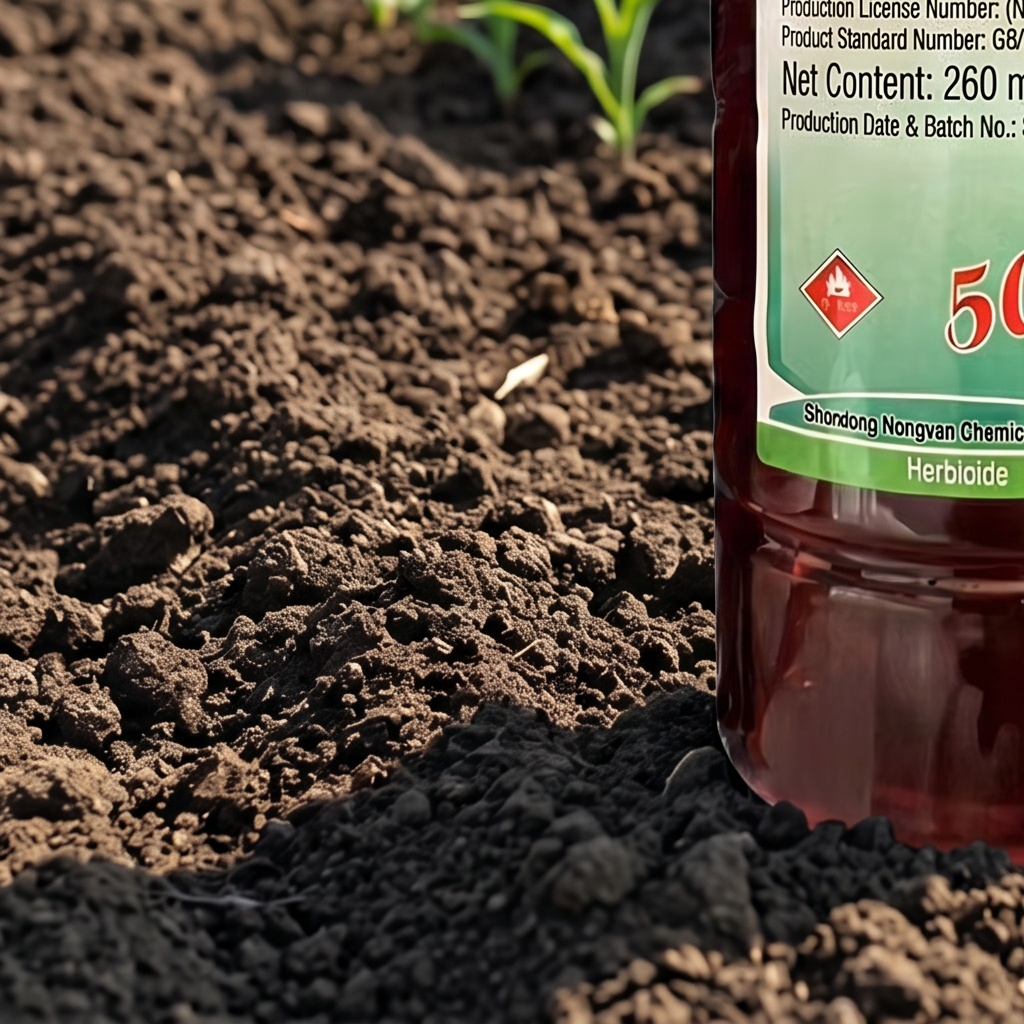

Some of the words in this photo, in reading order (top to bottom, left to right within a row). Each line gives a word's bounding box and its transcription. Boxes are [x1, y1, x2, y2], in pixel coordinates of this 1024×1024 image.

[782, 25, 834, 49] Product
[837, 27, 908, 50] Standard
[913, 28, 986, 50] Number:
[782, 60, 818, 97] Net
[826, 62, 933, 100] Content:
[943, 64, 998, 101] 260
[782, 107, 858, 135] Production
[863, 113, 900, 137] Date
[905, 114, 919, 138] &
[924, 114, 974, 138] Batch
[980, 114, 1016, 138] No.:
